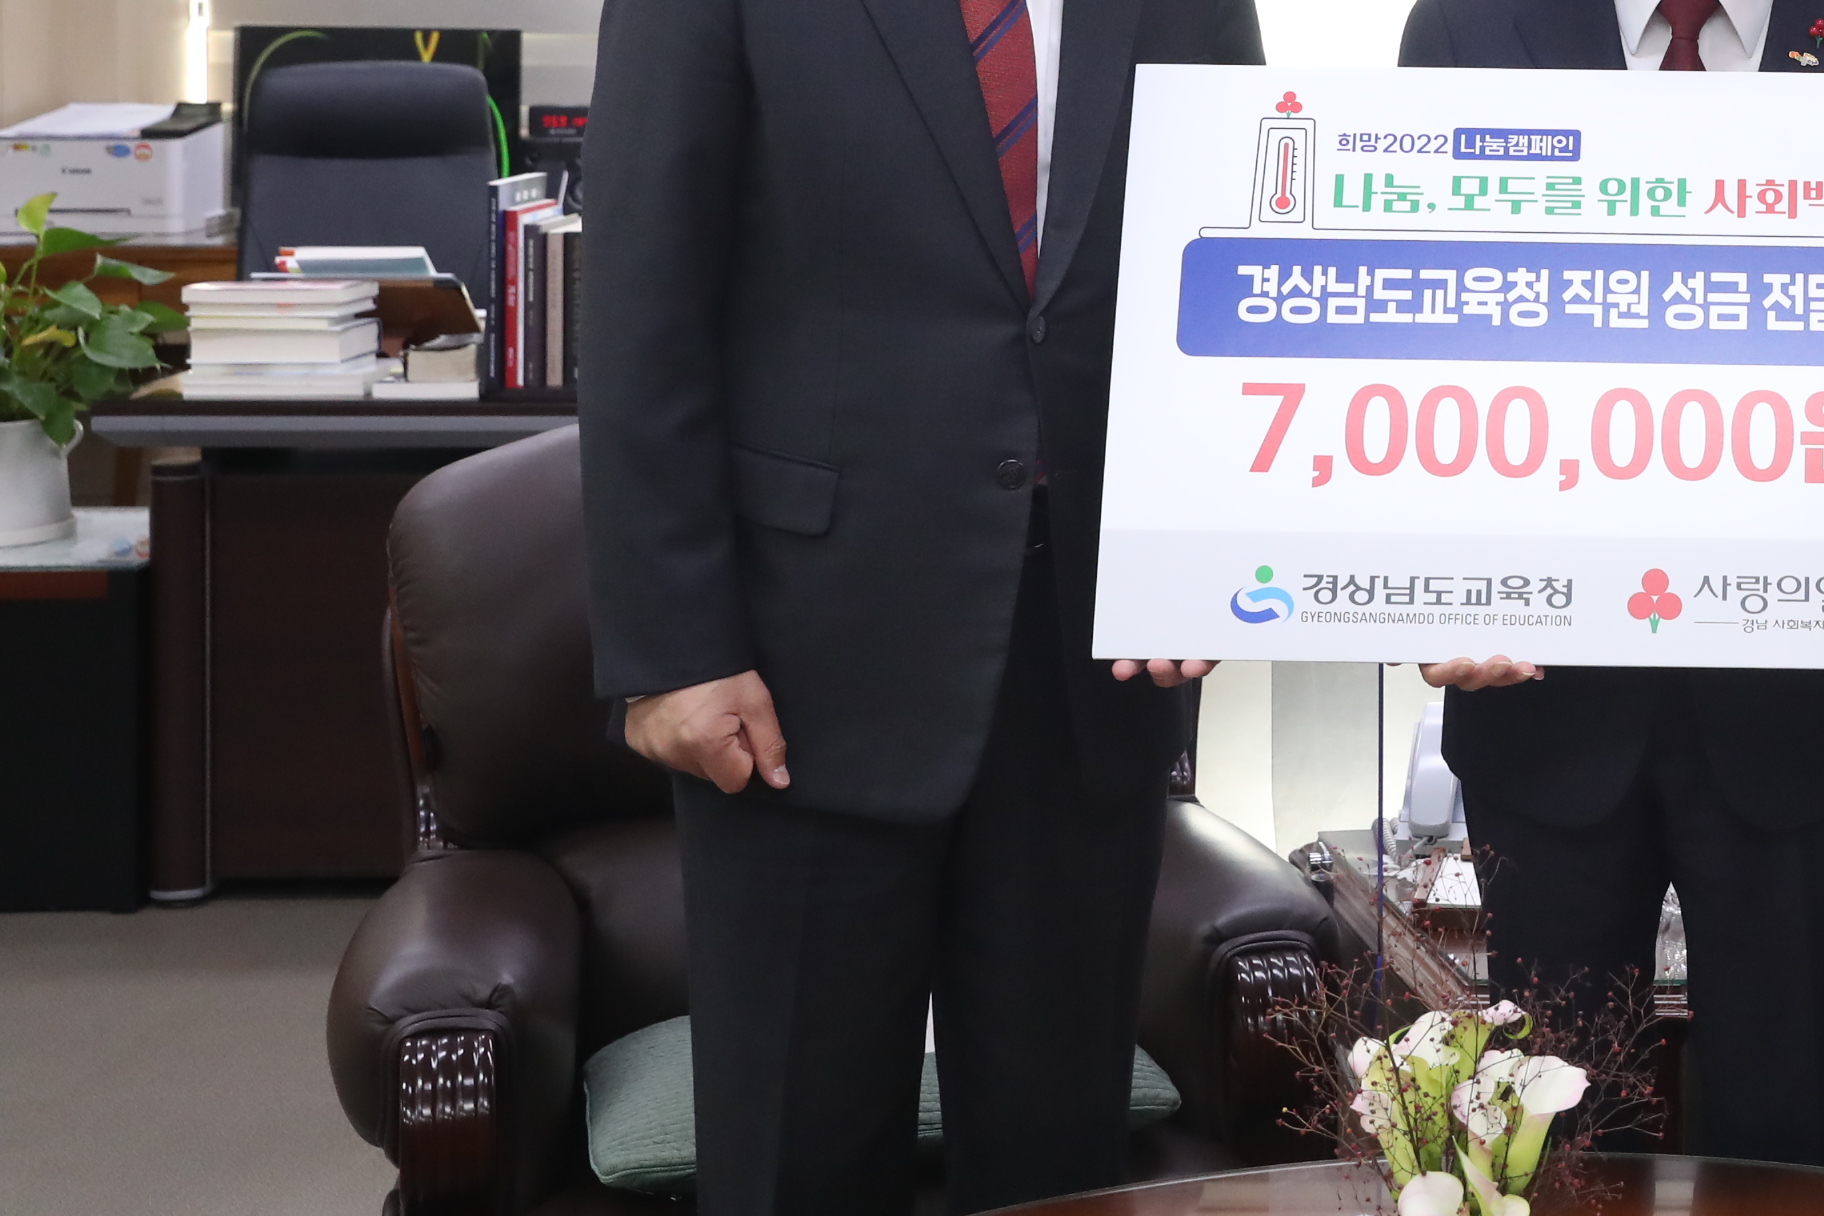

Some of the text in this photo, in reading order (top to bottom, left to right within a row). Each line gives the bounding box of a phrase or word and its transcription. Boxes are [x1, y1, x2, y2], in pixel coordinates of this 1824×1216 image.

[1337, 133, 1574, 157] 희망2022 나눔캠페인
[1333, 173, 1437, 214] 나눔,
[1447, 176, 1586, 216] 모두를
[1597, 177, 1692, 218] 위한
[1237, 264, 1549, 327] 경상남도교육청
[1561, 269, 1649, 328] 직원
[1661, 271, 1751, 330] 성금
[1302, 573, 1573, 609] 경상남도교육청
[1300, 611, 1573, 627] GYEONGSANGNAMDO OFFICE OF EDUCATION
[1742, 619, 1769, 634] 경남
